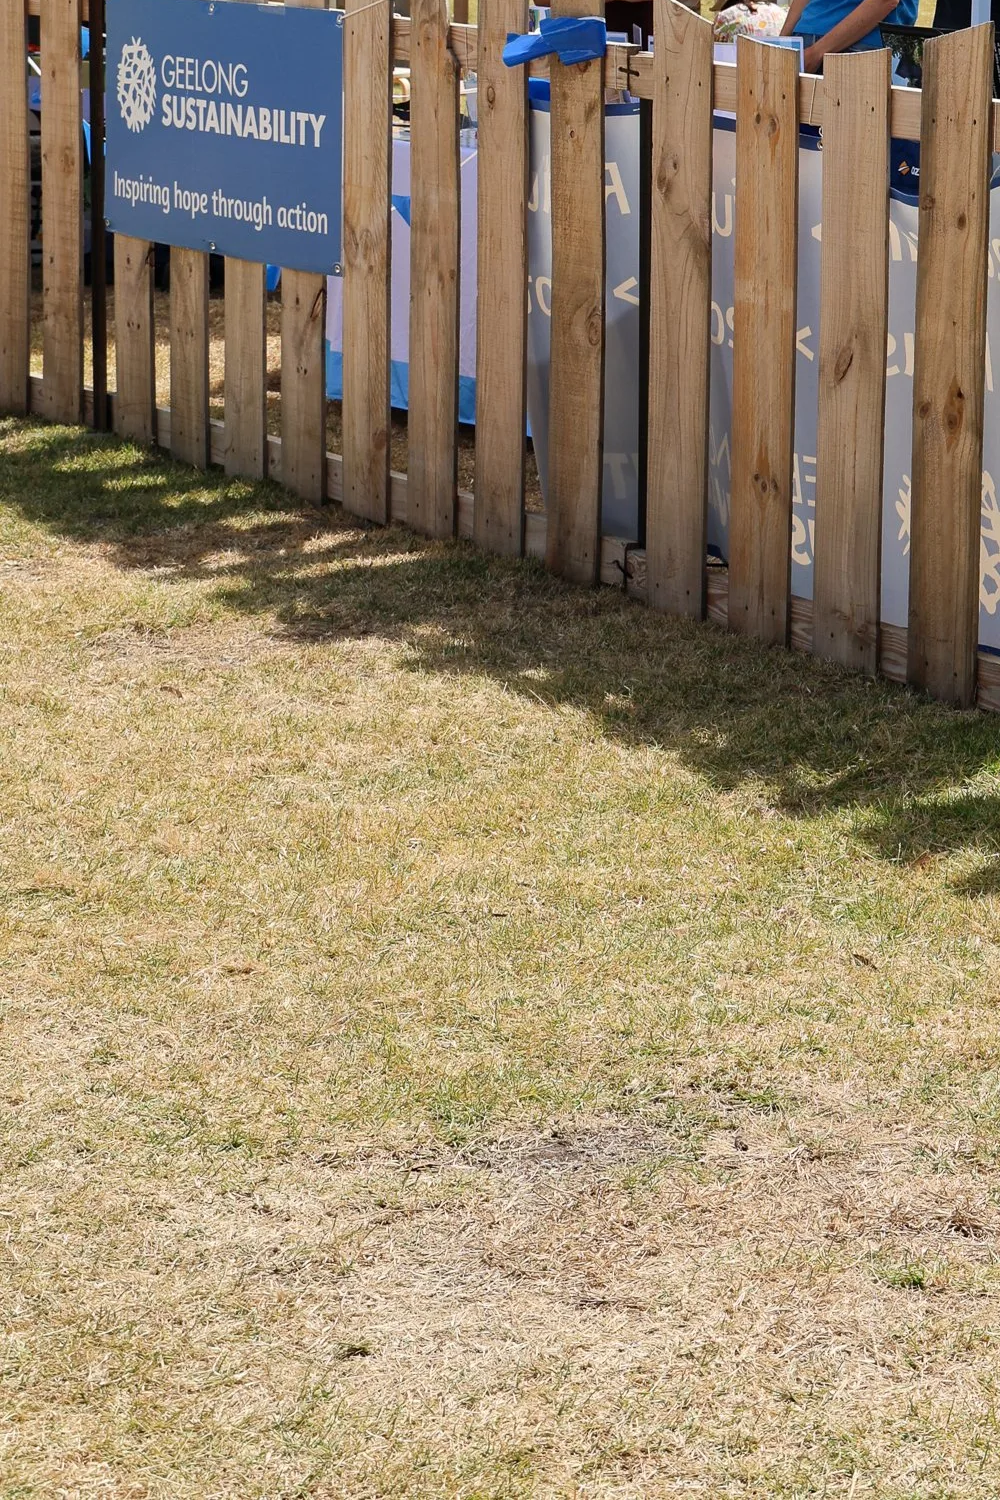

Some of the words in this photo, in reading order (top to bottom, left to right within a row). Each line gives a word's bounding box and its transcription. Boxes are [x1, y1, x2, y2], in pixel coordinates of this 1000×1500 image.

[161, 55, 248, 97] GEELONG
[161, 93, 326, 147] SUSTAINABILITY
[114, 170, 170, 214] Inspiring
[174, 181, 208, 219] hope
[212, 189, 272, 231] through
[277, 202, 327, 234] action
